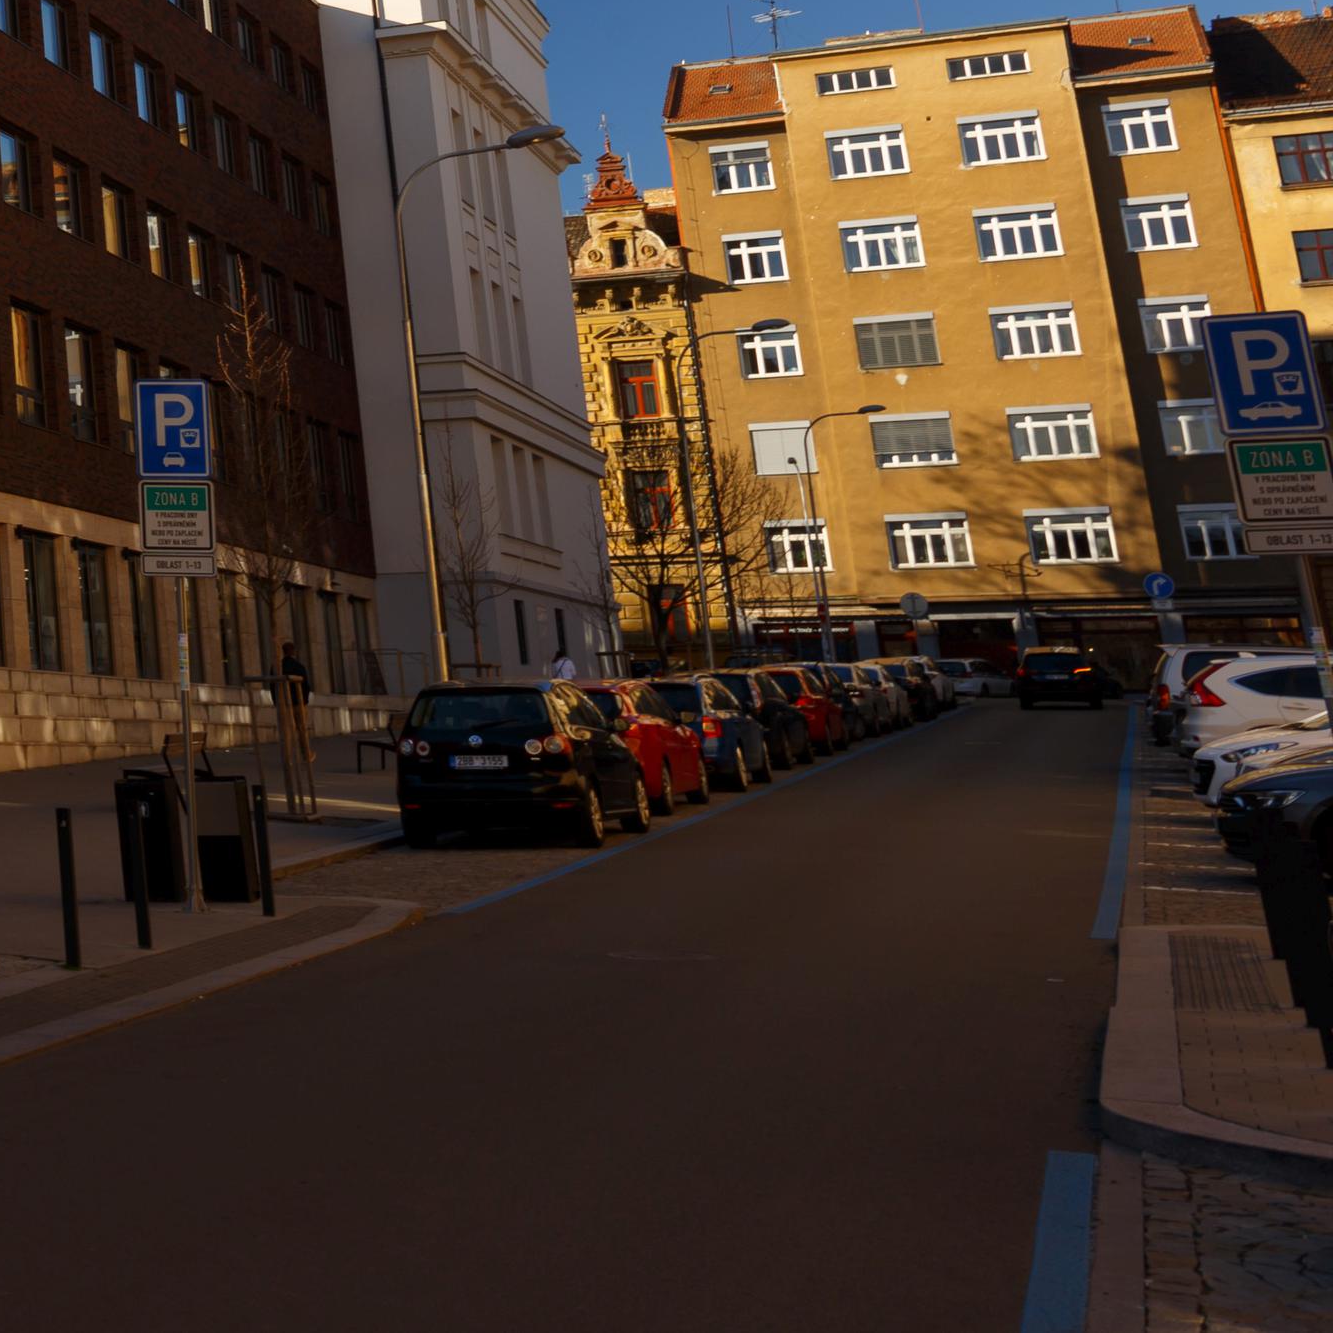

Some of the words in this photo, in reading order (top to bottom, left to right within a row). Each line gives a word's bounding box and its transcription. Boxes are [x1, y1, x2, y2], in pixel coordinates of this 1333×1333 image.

[1231, 329, 1290, 396] P
[155, 393, 194, 447] P
[1249, 447, 1297, 468] ZÓNA
[1302, 449, 1314, 466] B
[191, 492, 199, 506] B
[1266, 534, 1304, 546] OBLAST
[156, 561, 182, 569] OBLAST
